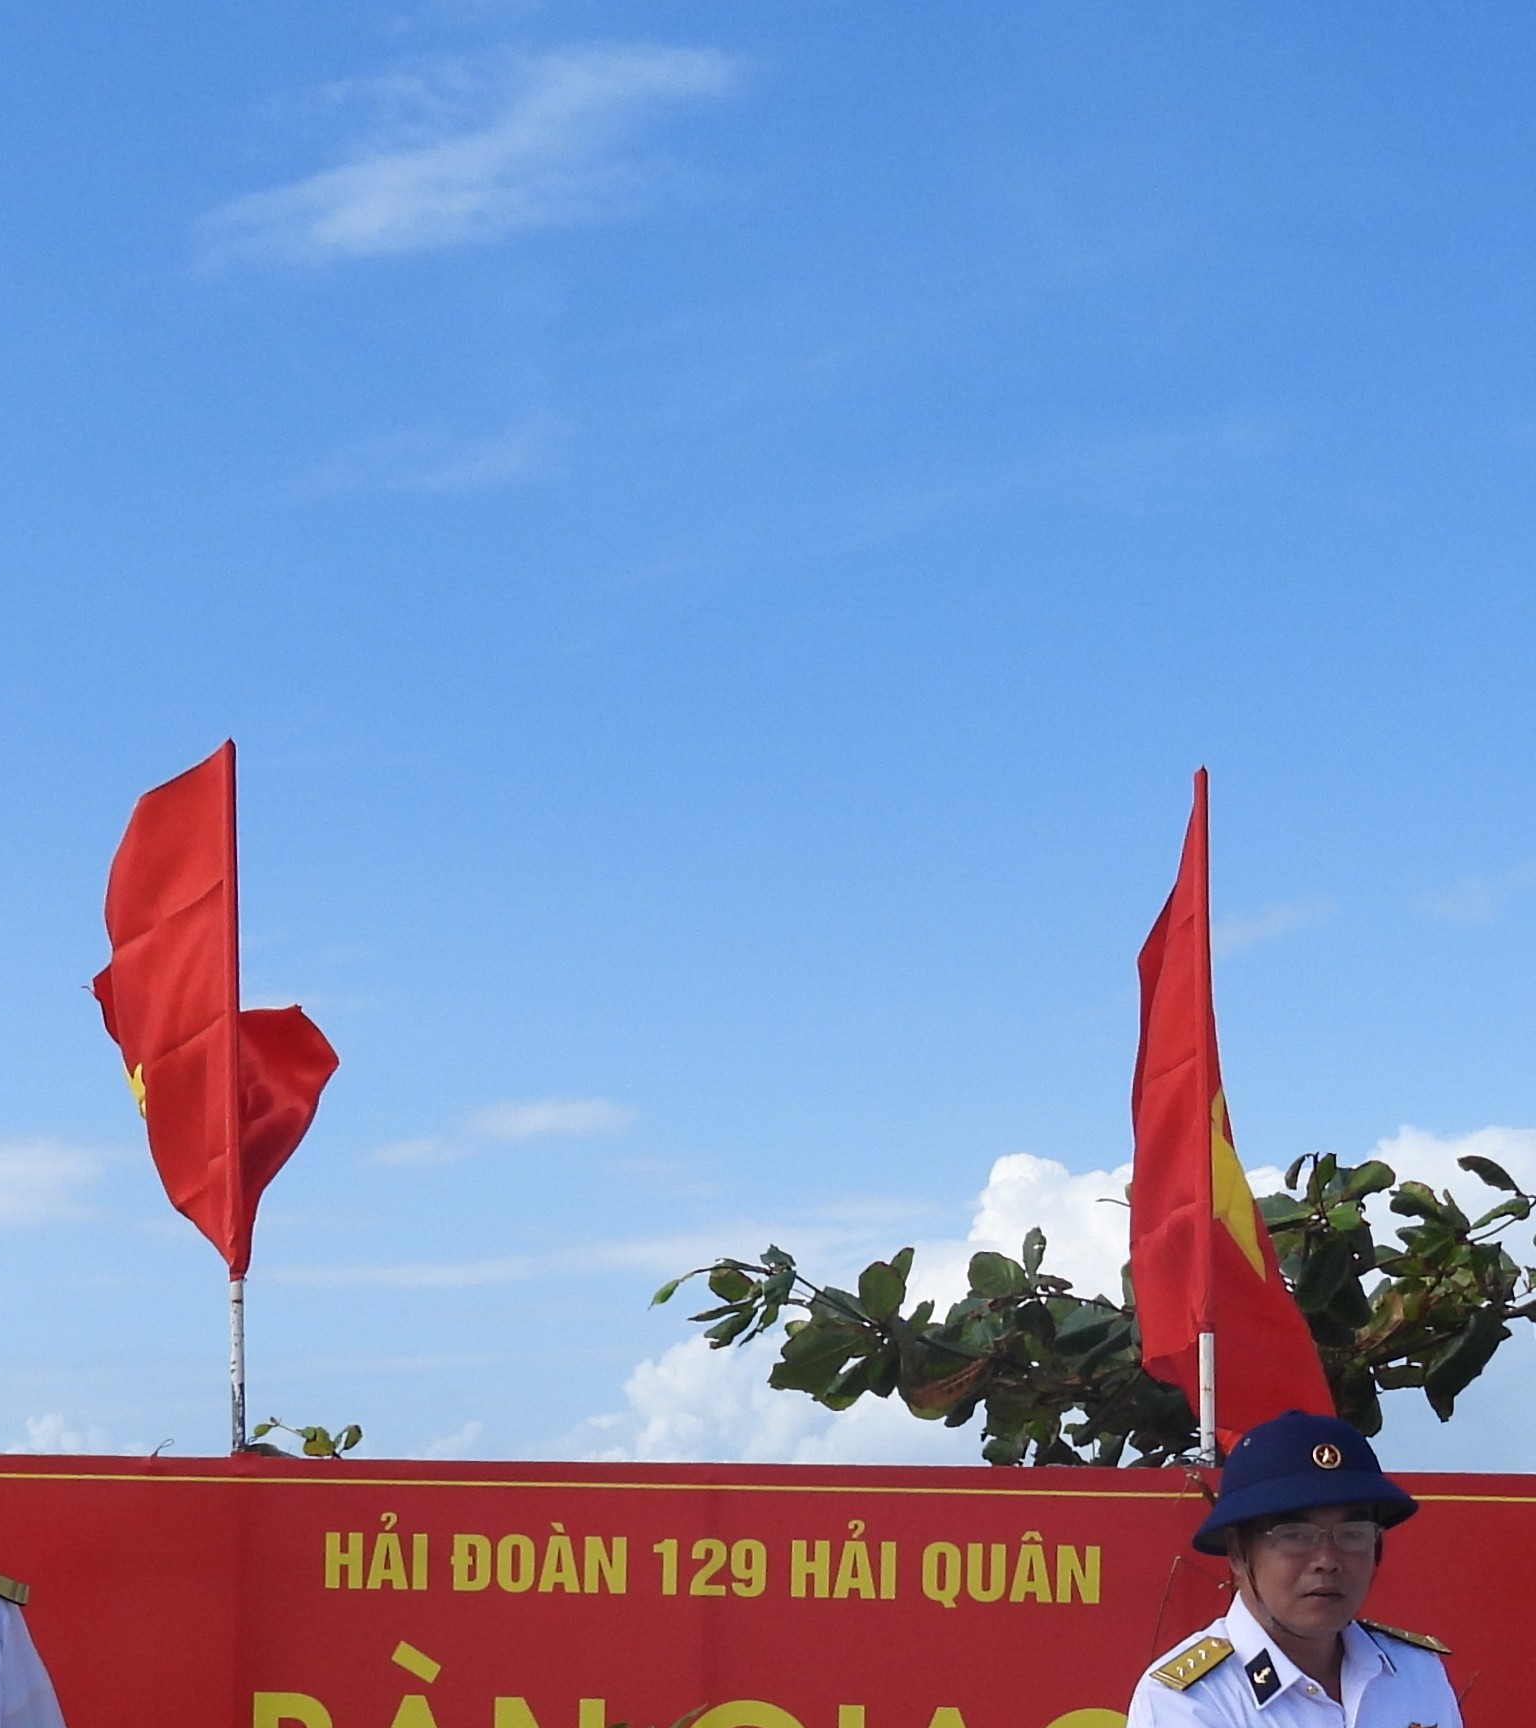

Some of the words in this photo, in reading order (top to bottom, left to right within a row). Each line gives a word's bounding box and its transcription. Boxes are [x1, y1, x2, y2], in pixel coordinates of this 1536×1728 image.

[325, 1512, 429, 1590] HẢI
[452, 1522, 628, 1595] ĐOÀN
[653, 1538, 767, 1597] 129
[791, 1520, 897, 1600] HẢI
[922, 1531, 1101, 1607] QUÂN
